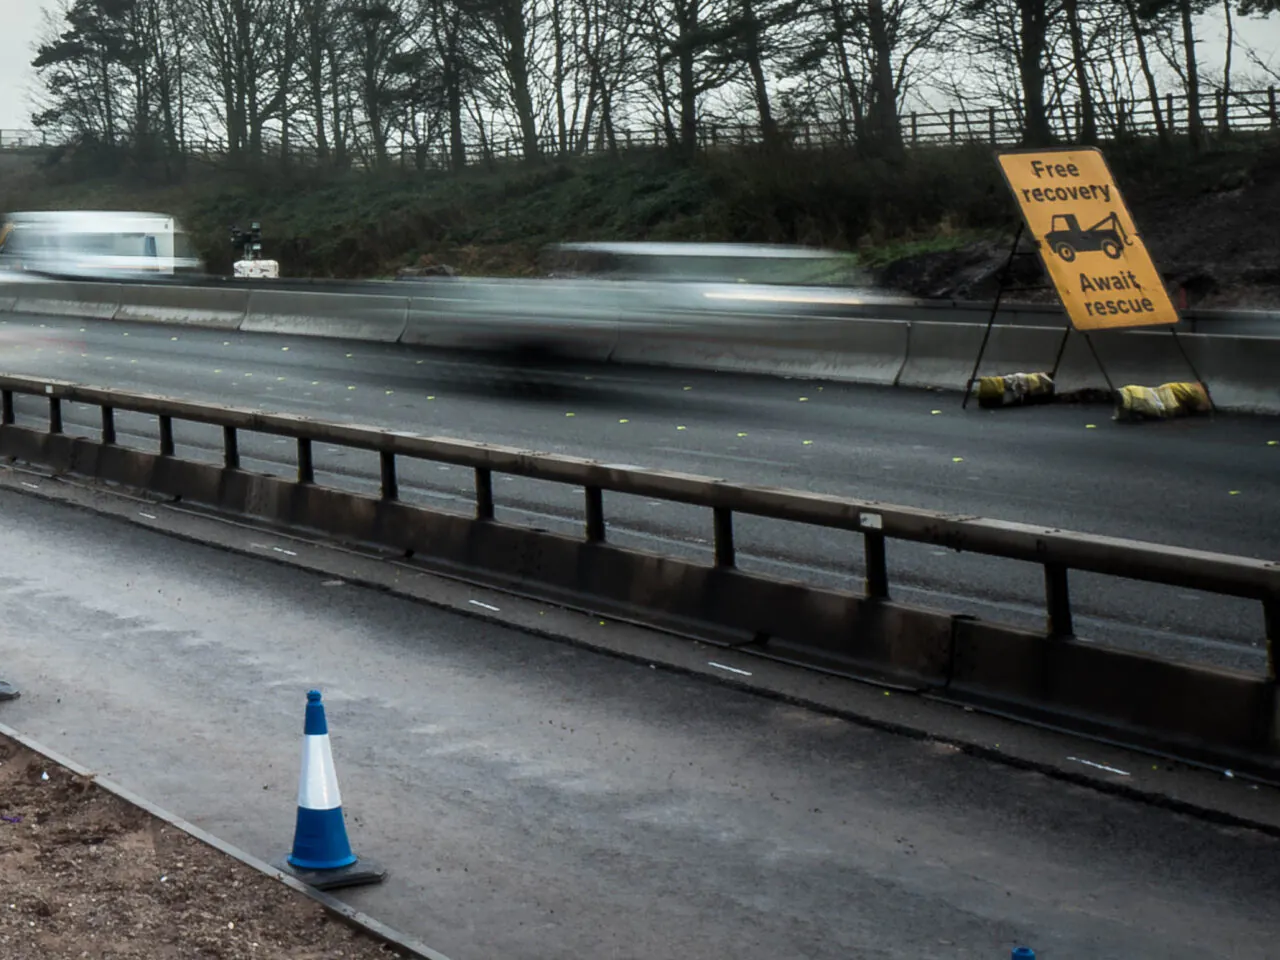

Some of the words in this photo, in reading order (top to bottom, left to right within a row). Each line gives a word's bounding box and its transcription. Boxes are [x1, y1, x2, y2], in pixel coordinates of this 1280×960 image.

[1030, 160, 1080, 179] Free
[1021, 184, 1111, 203] recovery
[1079, 270, 1139, 292] Await
[1084, 296, 1155, 316] rescue
